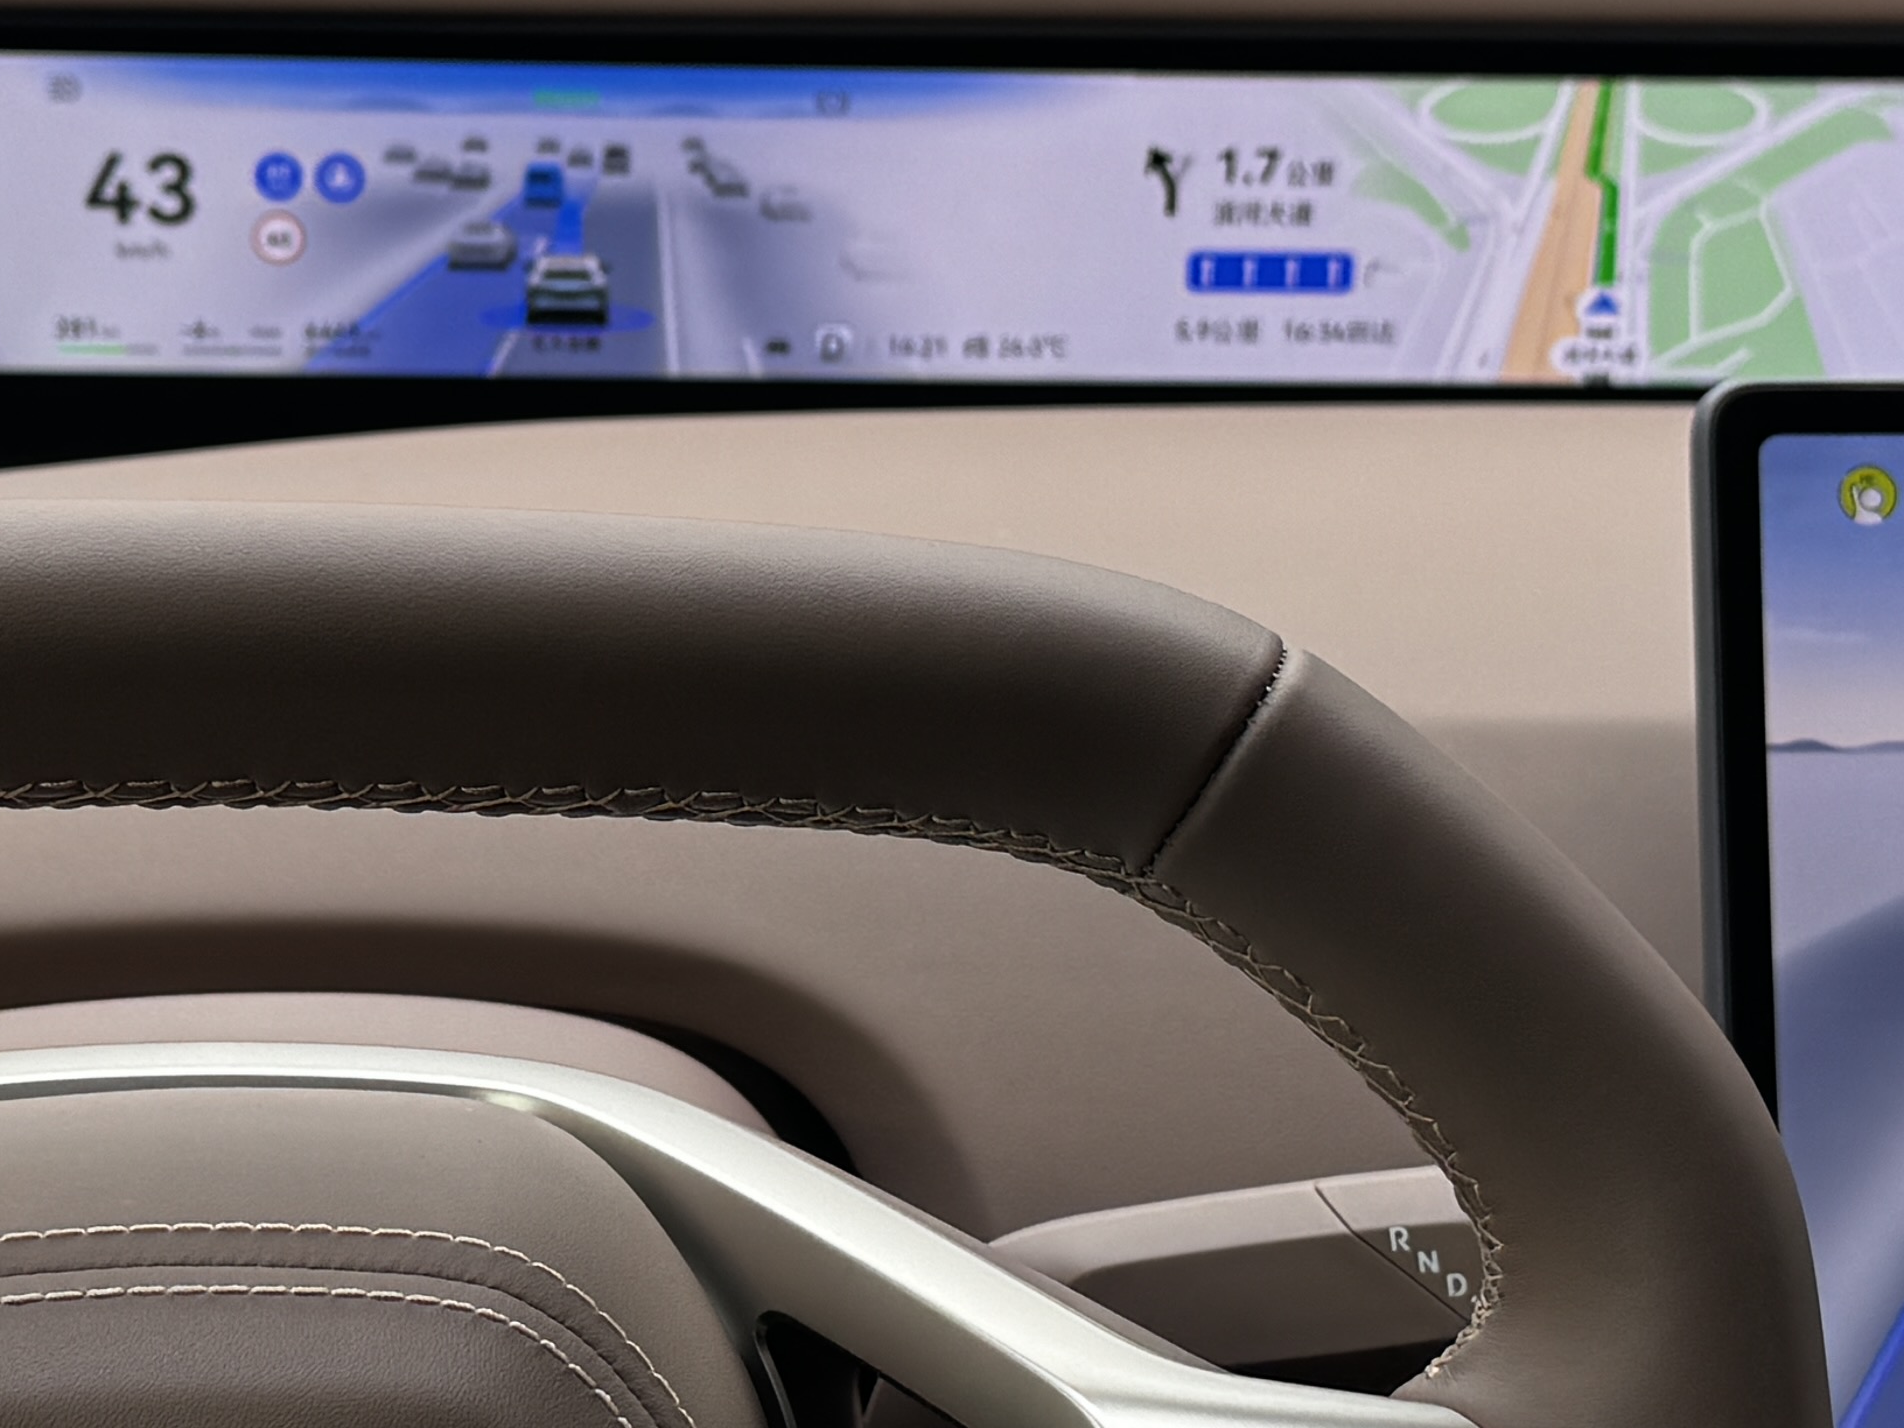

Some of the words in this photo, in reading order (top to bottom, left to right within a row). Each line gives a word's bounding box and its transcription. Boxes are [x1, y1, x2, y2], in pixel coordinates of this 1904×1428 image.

[86, 152, 196, 226] 43
[1388, 1225, 1411, 1253] R
[1417, 1250, 1439, 1274] N
[1447, 1272, 1468, 1297] D
